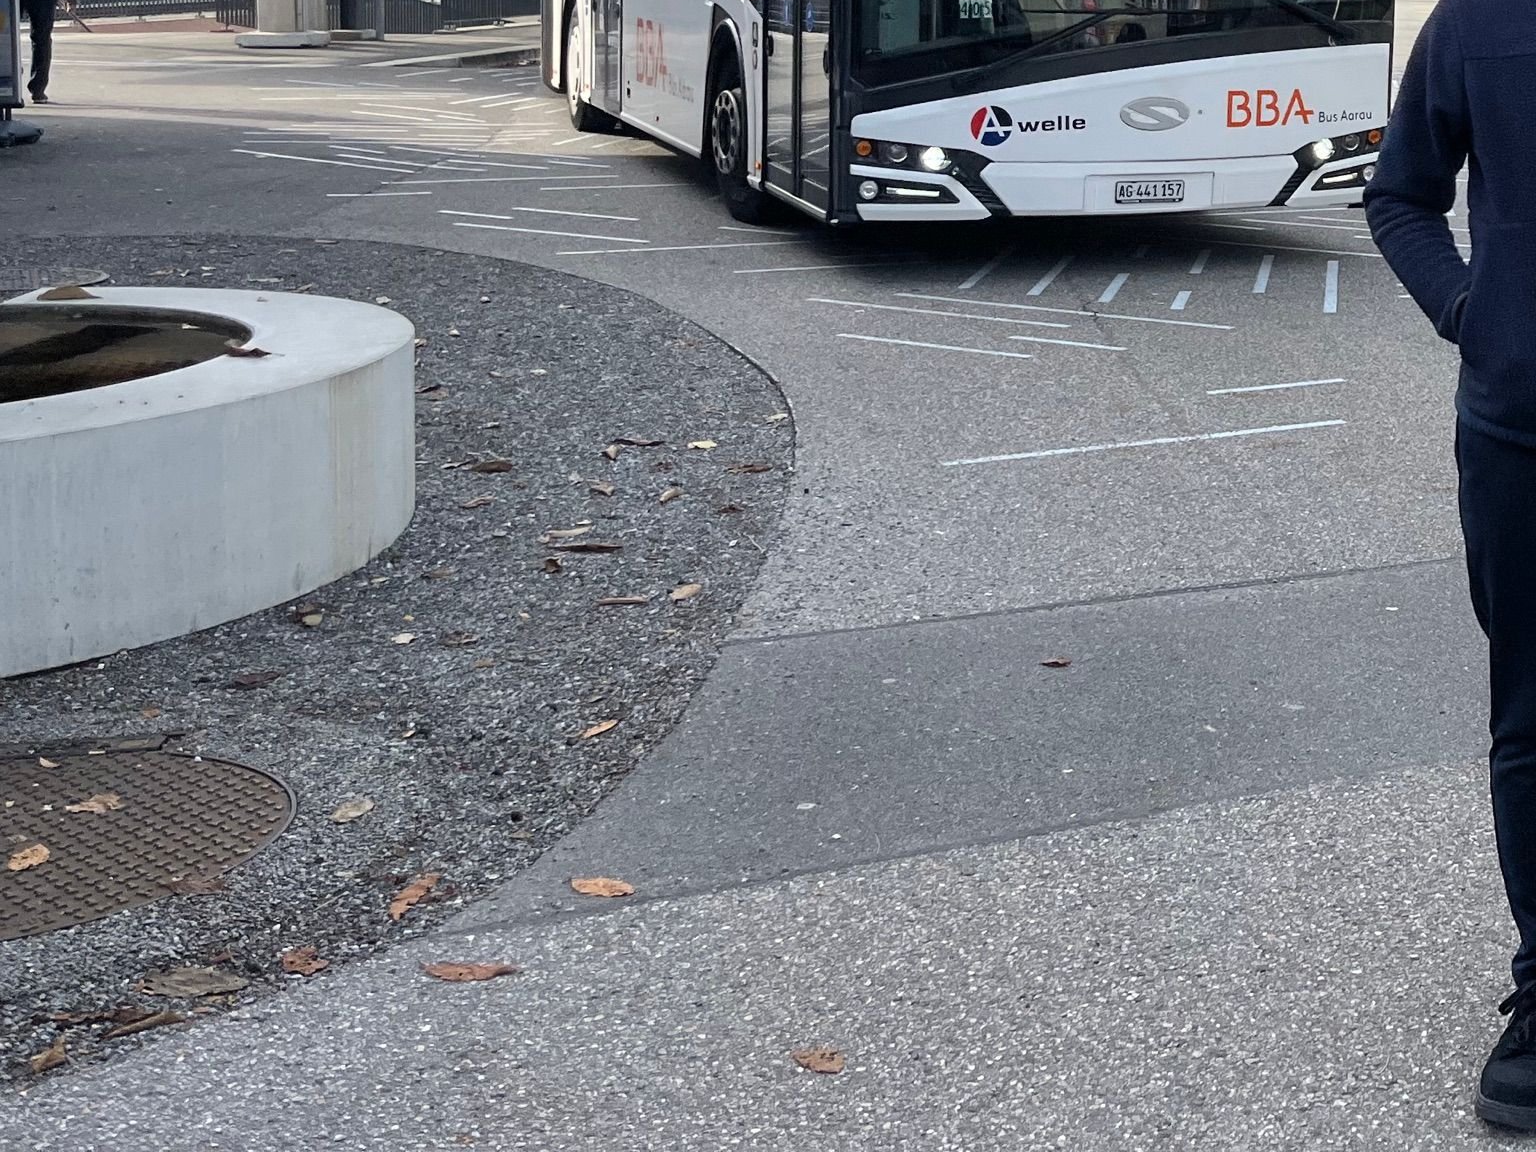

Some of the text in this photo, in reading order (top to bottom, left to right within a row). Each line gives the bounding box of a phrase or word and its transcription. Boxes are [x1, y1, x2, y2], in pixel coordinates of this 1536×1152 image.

[959, 0, 991, 17] 405
[1226, 88, 1372, 128] BBA Bus Aarau
[1017, 115, 1086, 133] welle
